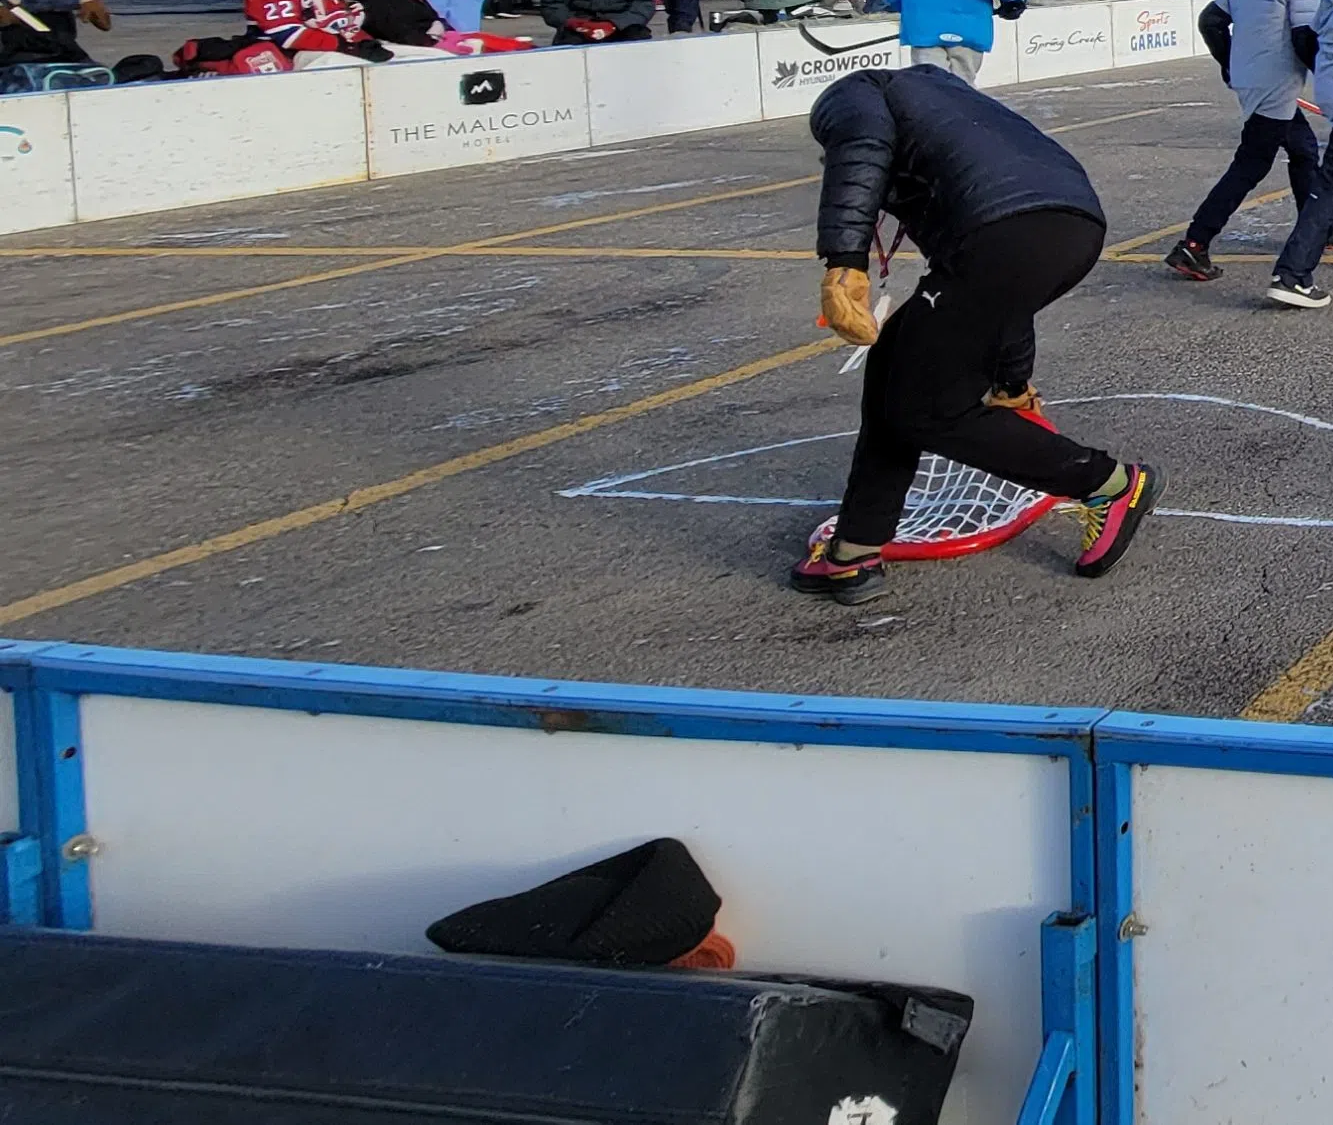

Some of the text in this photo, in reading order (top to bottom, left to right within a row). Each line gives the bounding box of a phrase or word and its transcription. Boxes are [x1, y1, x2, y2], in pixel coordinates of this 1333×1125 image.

[263, 0, 296, 21] 22
[1136, 10, 1172, 32] Sports
[1025, 35, 1065, 55] Spring
[1130, 30, 1177, 52] GARAGE
[801, 51, 893, 75] CROWFOOT
[390, 108, 574, 144] THE MALCOLM
[462, 136, 511, 149] HOTEL
